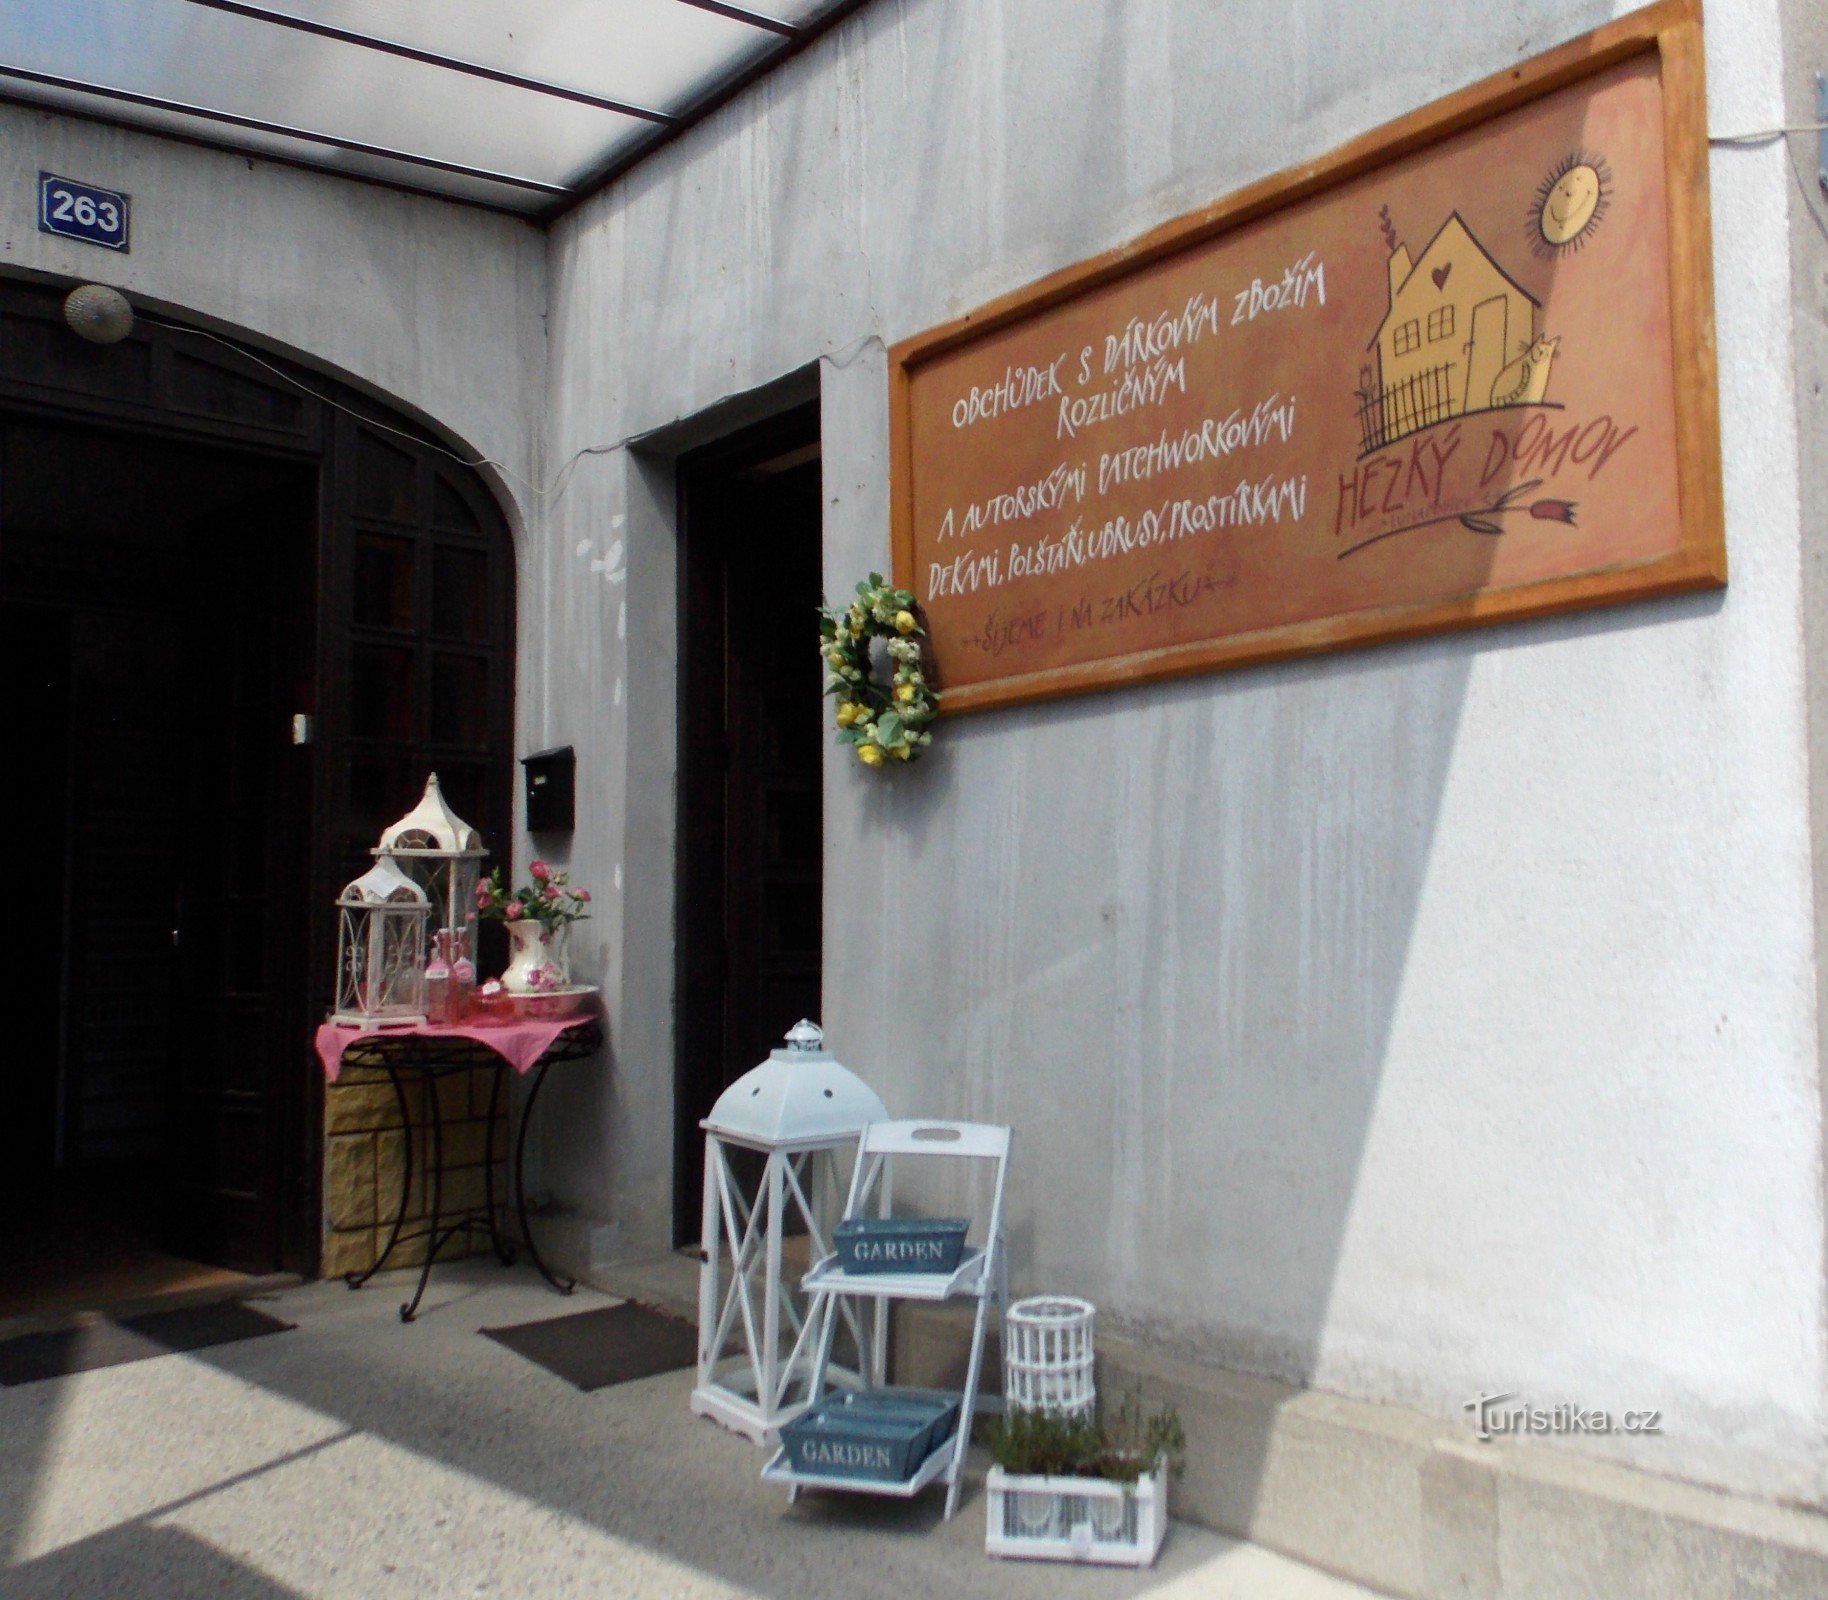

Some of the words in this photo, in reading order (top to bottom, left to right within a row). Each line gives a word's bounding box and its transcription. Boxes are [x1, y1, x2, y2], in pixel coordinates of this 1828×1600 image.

[53, 190, 119, 232] 263
[951, 353, 1066, 429] OBCHŮDEK
[1078, 346, 1092, 385] S
[1104, 292, 1218, 375] DÁRKOVÝM
[1230, 250, 1326, 326] ZBOŽÍM
[1056, 356, 1185, 440] ROZLIČNÝM
[960, 461, 1087, 537] AUTORSKÝMI
[1099, 392, 1295, 495] PATCHWORKOVÝMI
[1335, 422, 1462, 536] HEZKÝ
[1479, 413, 1639, 489] DOMOV
[853, 1240, 945, 1261] GARDEN
[802, 1439, 891, 1469] GARDEN
